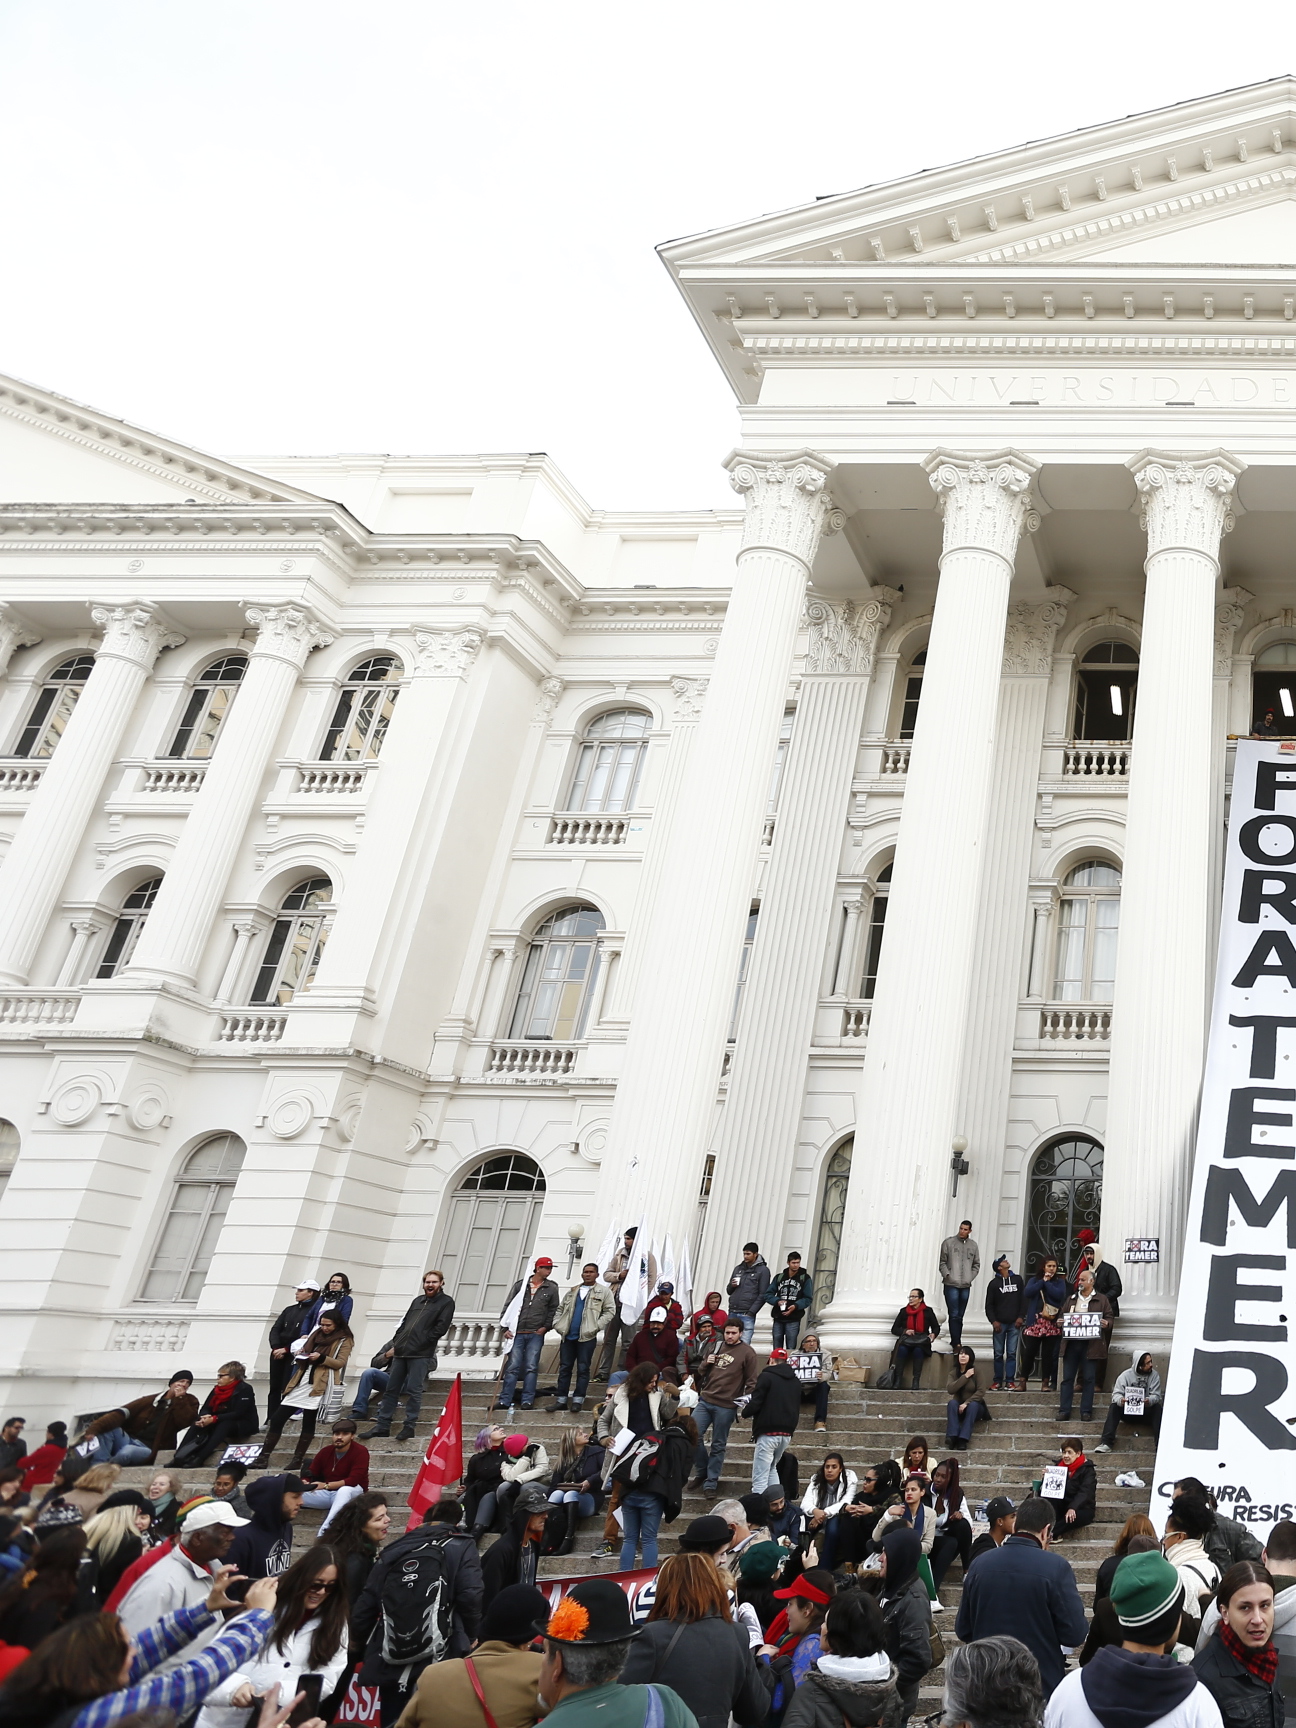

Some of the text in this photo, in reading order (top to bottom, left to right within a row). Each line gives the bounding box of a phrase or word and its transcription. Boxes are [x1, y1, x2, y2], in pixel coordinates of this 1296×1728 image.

[891, 376, 1291, 403] UNIVERSIDADE
[1125, 1240, 1157, 1251] FORA
[1125, 1251, 1158, 1260] TEMER
[999, 1284, 1018, 1294] VANS
[1063, 1315, 1101, 1327] FORA
[1063, 1326, 1100, 1337] TEMER
[1158, 1481, 1252, 1503] CURA
